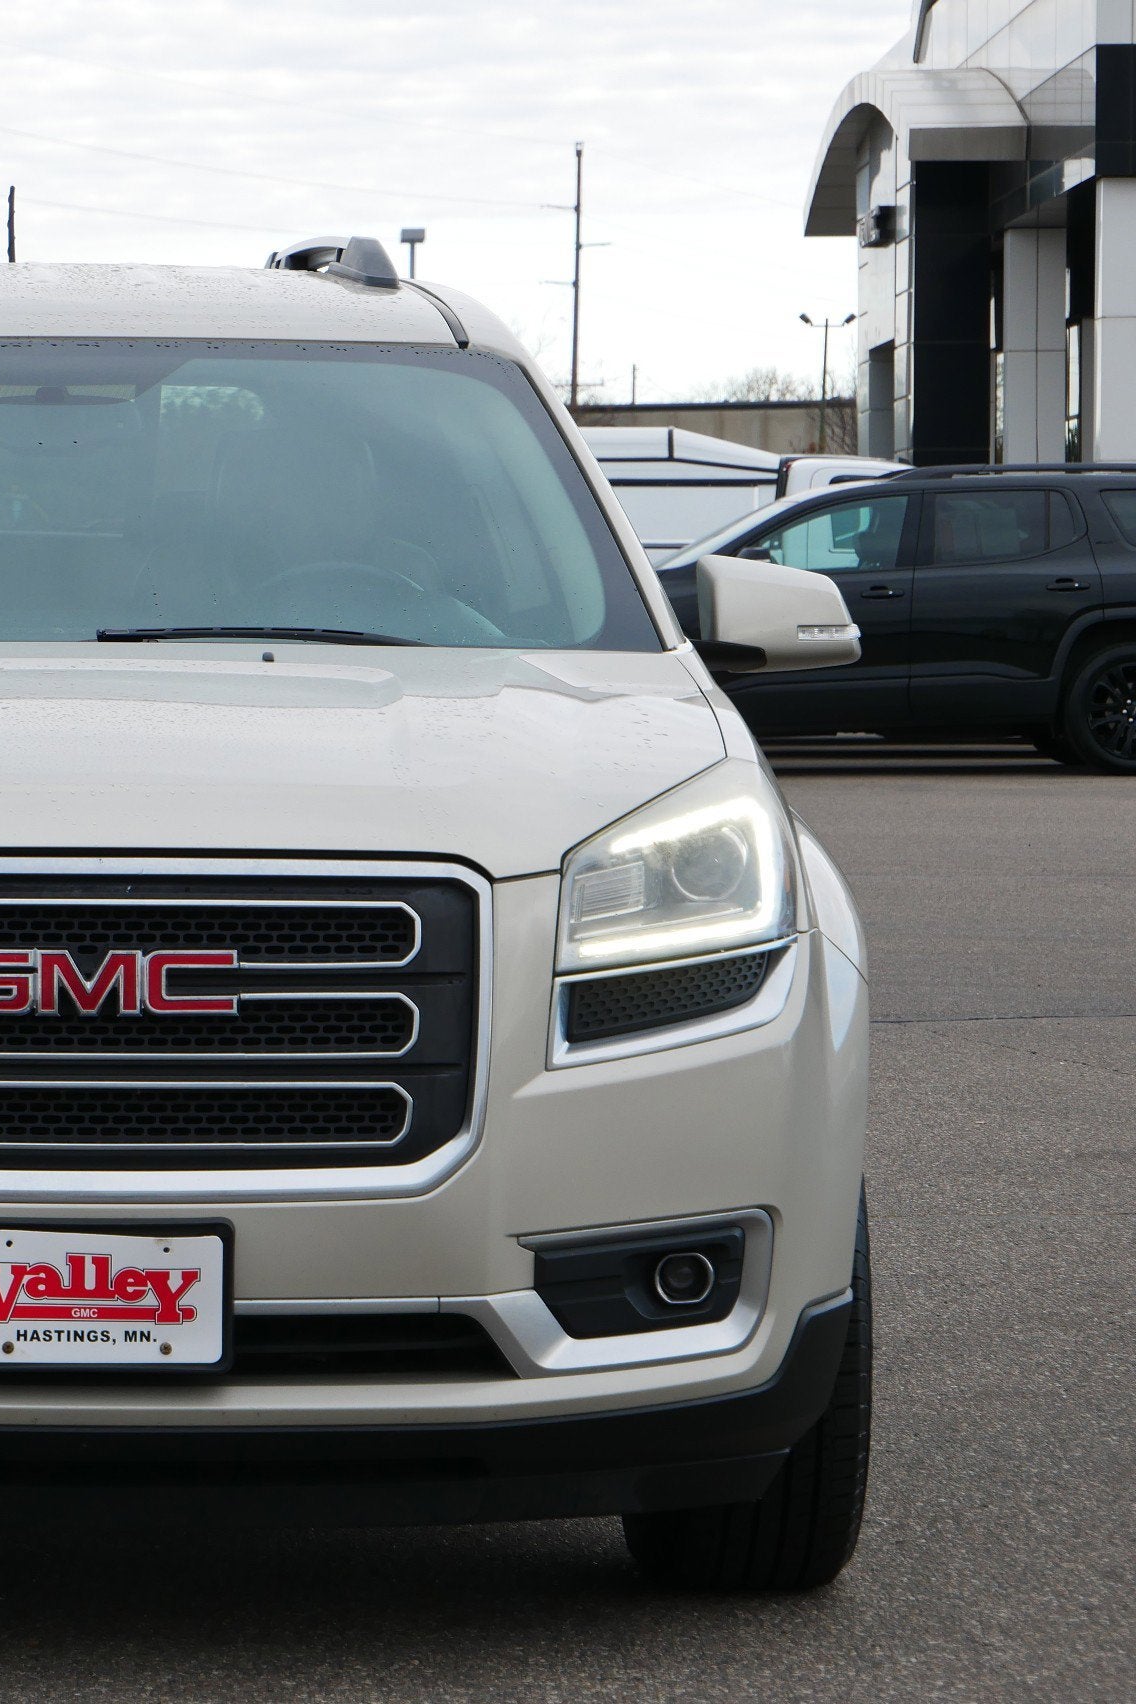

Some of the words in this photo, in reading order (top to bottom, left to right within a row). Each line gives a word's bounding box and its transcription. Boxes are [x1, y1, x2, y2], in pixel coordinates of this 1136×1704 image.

[71, 1308, 98, 1319] GMC
[16, 1329, 117, 1346] HASTINGS,
[124, 1331, 158, 1343] MN.
